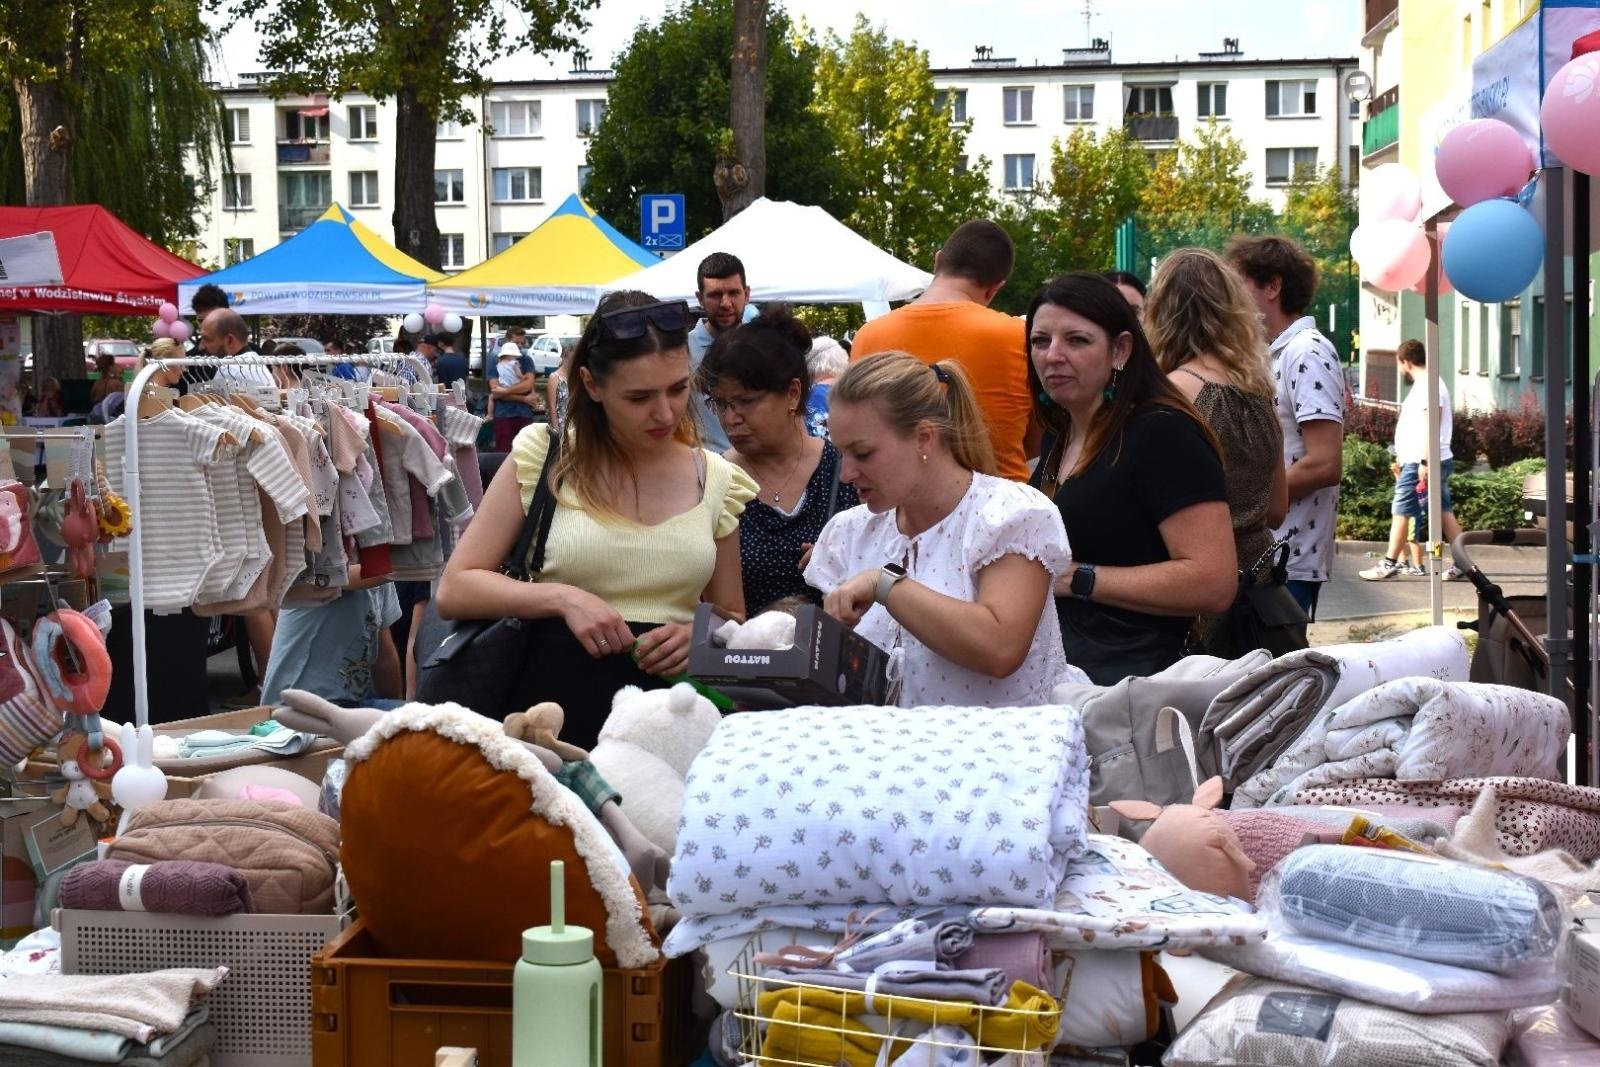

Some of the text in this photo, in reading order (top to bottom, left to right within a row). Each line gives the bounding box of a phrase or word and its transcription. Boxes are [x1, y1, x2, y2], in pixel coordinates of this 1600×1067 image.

[652, 200, 675, 233] P
[645, 236, 658, 246] 2x
[19, 289, 31, 298] w
[34, 288, 112, 302] Wodzisławiu
[115, 292, 165, 307] Śląskim
[814, 620, 823, 670] NATTOU
[724, 654, 770, 664] NATTOU
